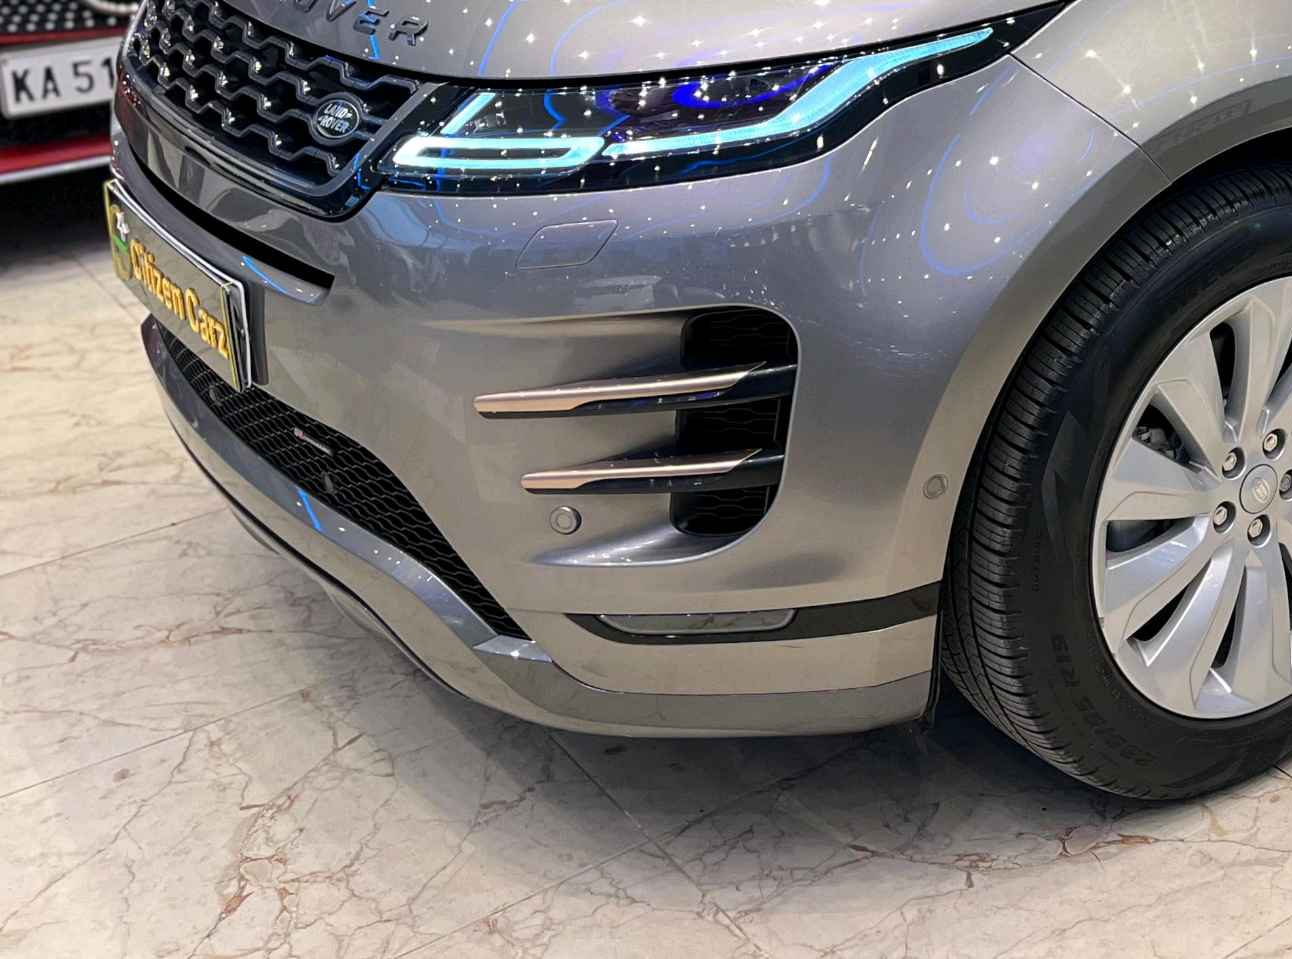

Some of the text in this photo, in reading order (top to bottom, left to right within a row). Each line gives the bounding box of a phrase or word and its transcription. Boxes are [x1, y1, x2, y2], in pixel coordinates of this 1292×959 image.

[12, 56, 116, 104] KA 51
[319, 115, 350, 133] ROVER
[323, 103, 349, 119] LAND
[129, 239, 230, 360] Citizen Carz
